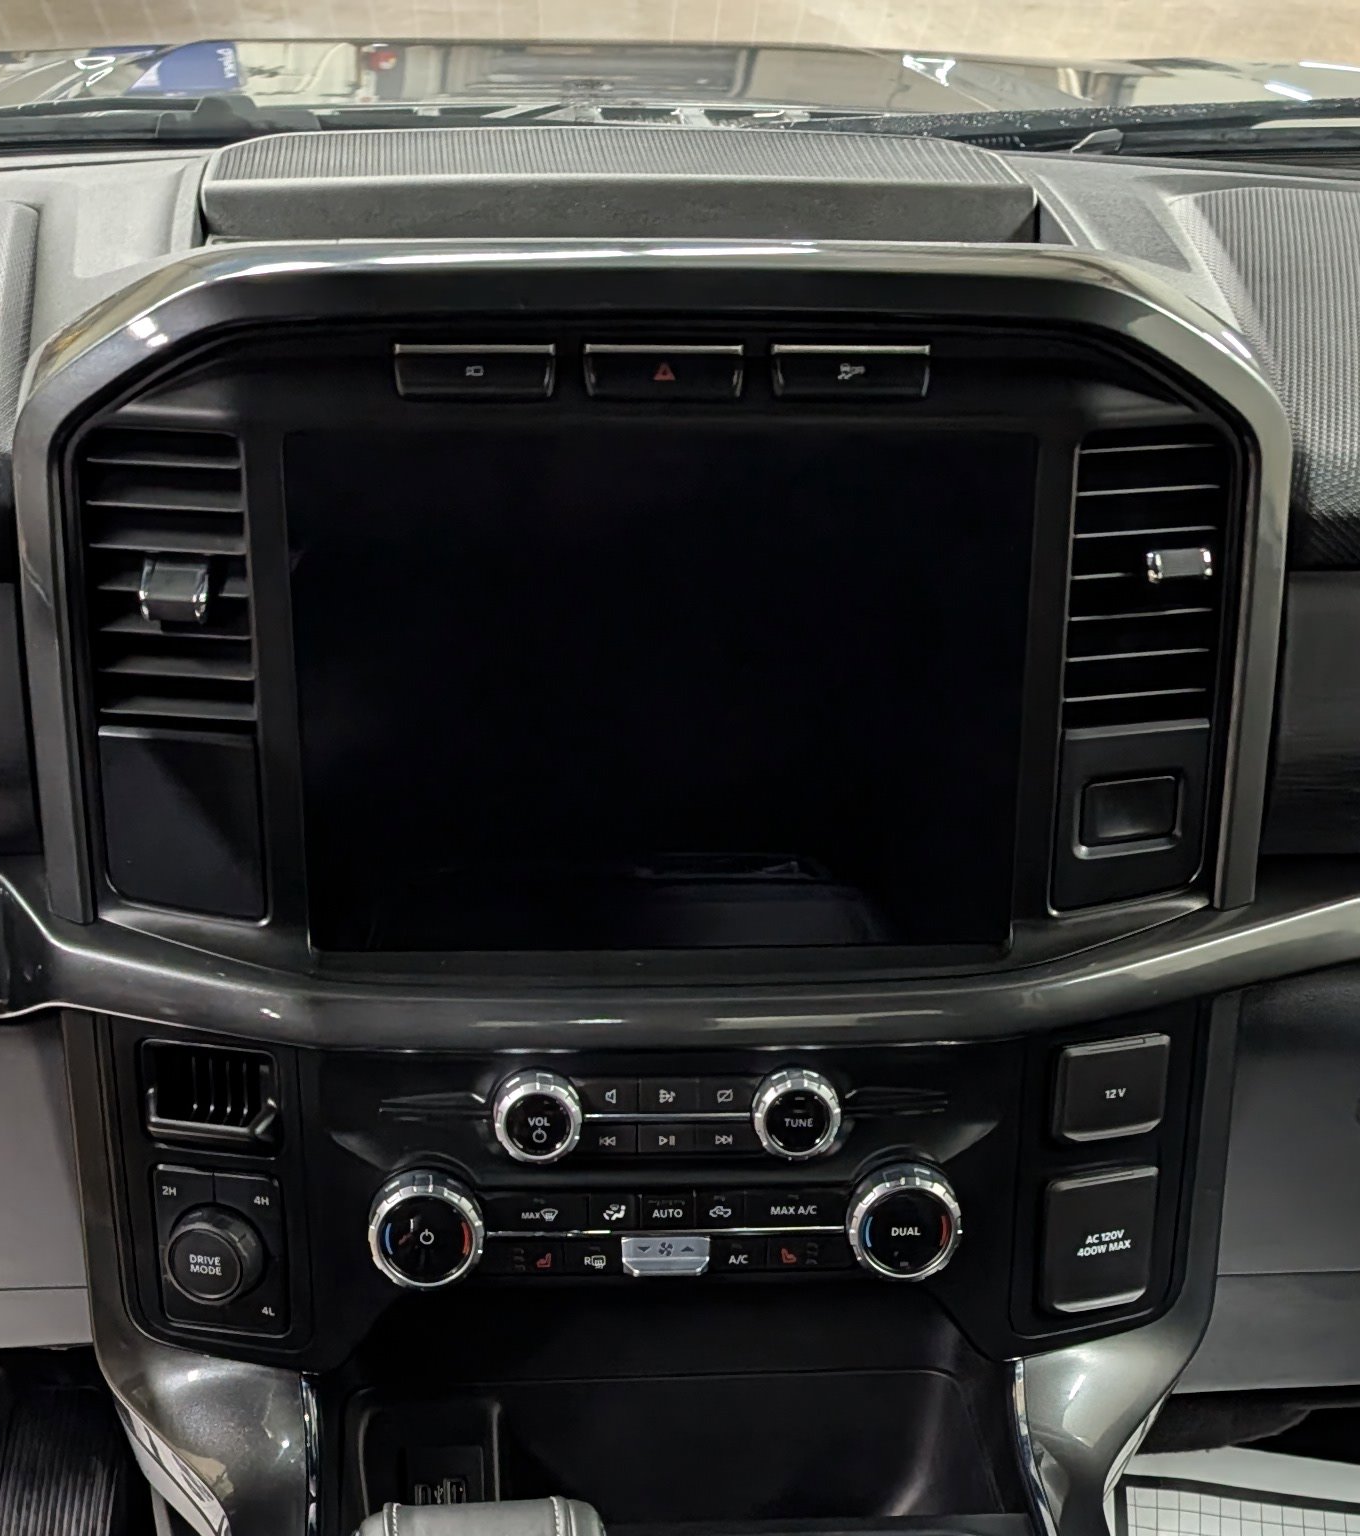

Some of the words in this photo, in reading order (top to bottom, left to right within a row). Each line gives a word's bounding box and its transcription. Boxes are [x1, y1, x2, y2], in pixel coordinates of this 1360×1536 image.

[528, 1117, 550, 1127] VOL
[785, 1118, 813, 1127] TUNE
[162, 1186, 177, 1196] 2H
[253, 1196, 269, 1206] 4H
[652, 1209, 683, 1218] AUTO
[770, 1206, 795, 1215] MAX
[798, 1205, 818, 1215] A/C
[521, 1212, 540, 1220] MAX
[891, 1227, 921, 1236] DUAL
[1085, 1234, 1100, 1244] AC
[1101, 1229, 1125, 1242] 120V
[1076, 1244, 1107, 1257] 400W
[1109, 1239, 1131, 1252] MAX
[189, 1254, 221, 1266] DRIVE
[729, 1255, 749, 1265] A/C
[190, 1264, 222, 1276] MODE
[261, 1306, 275, 1317] 4L
